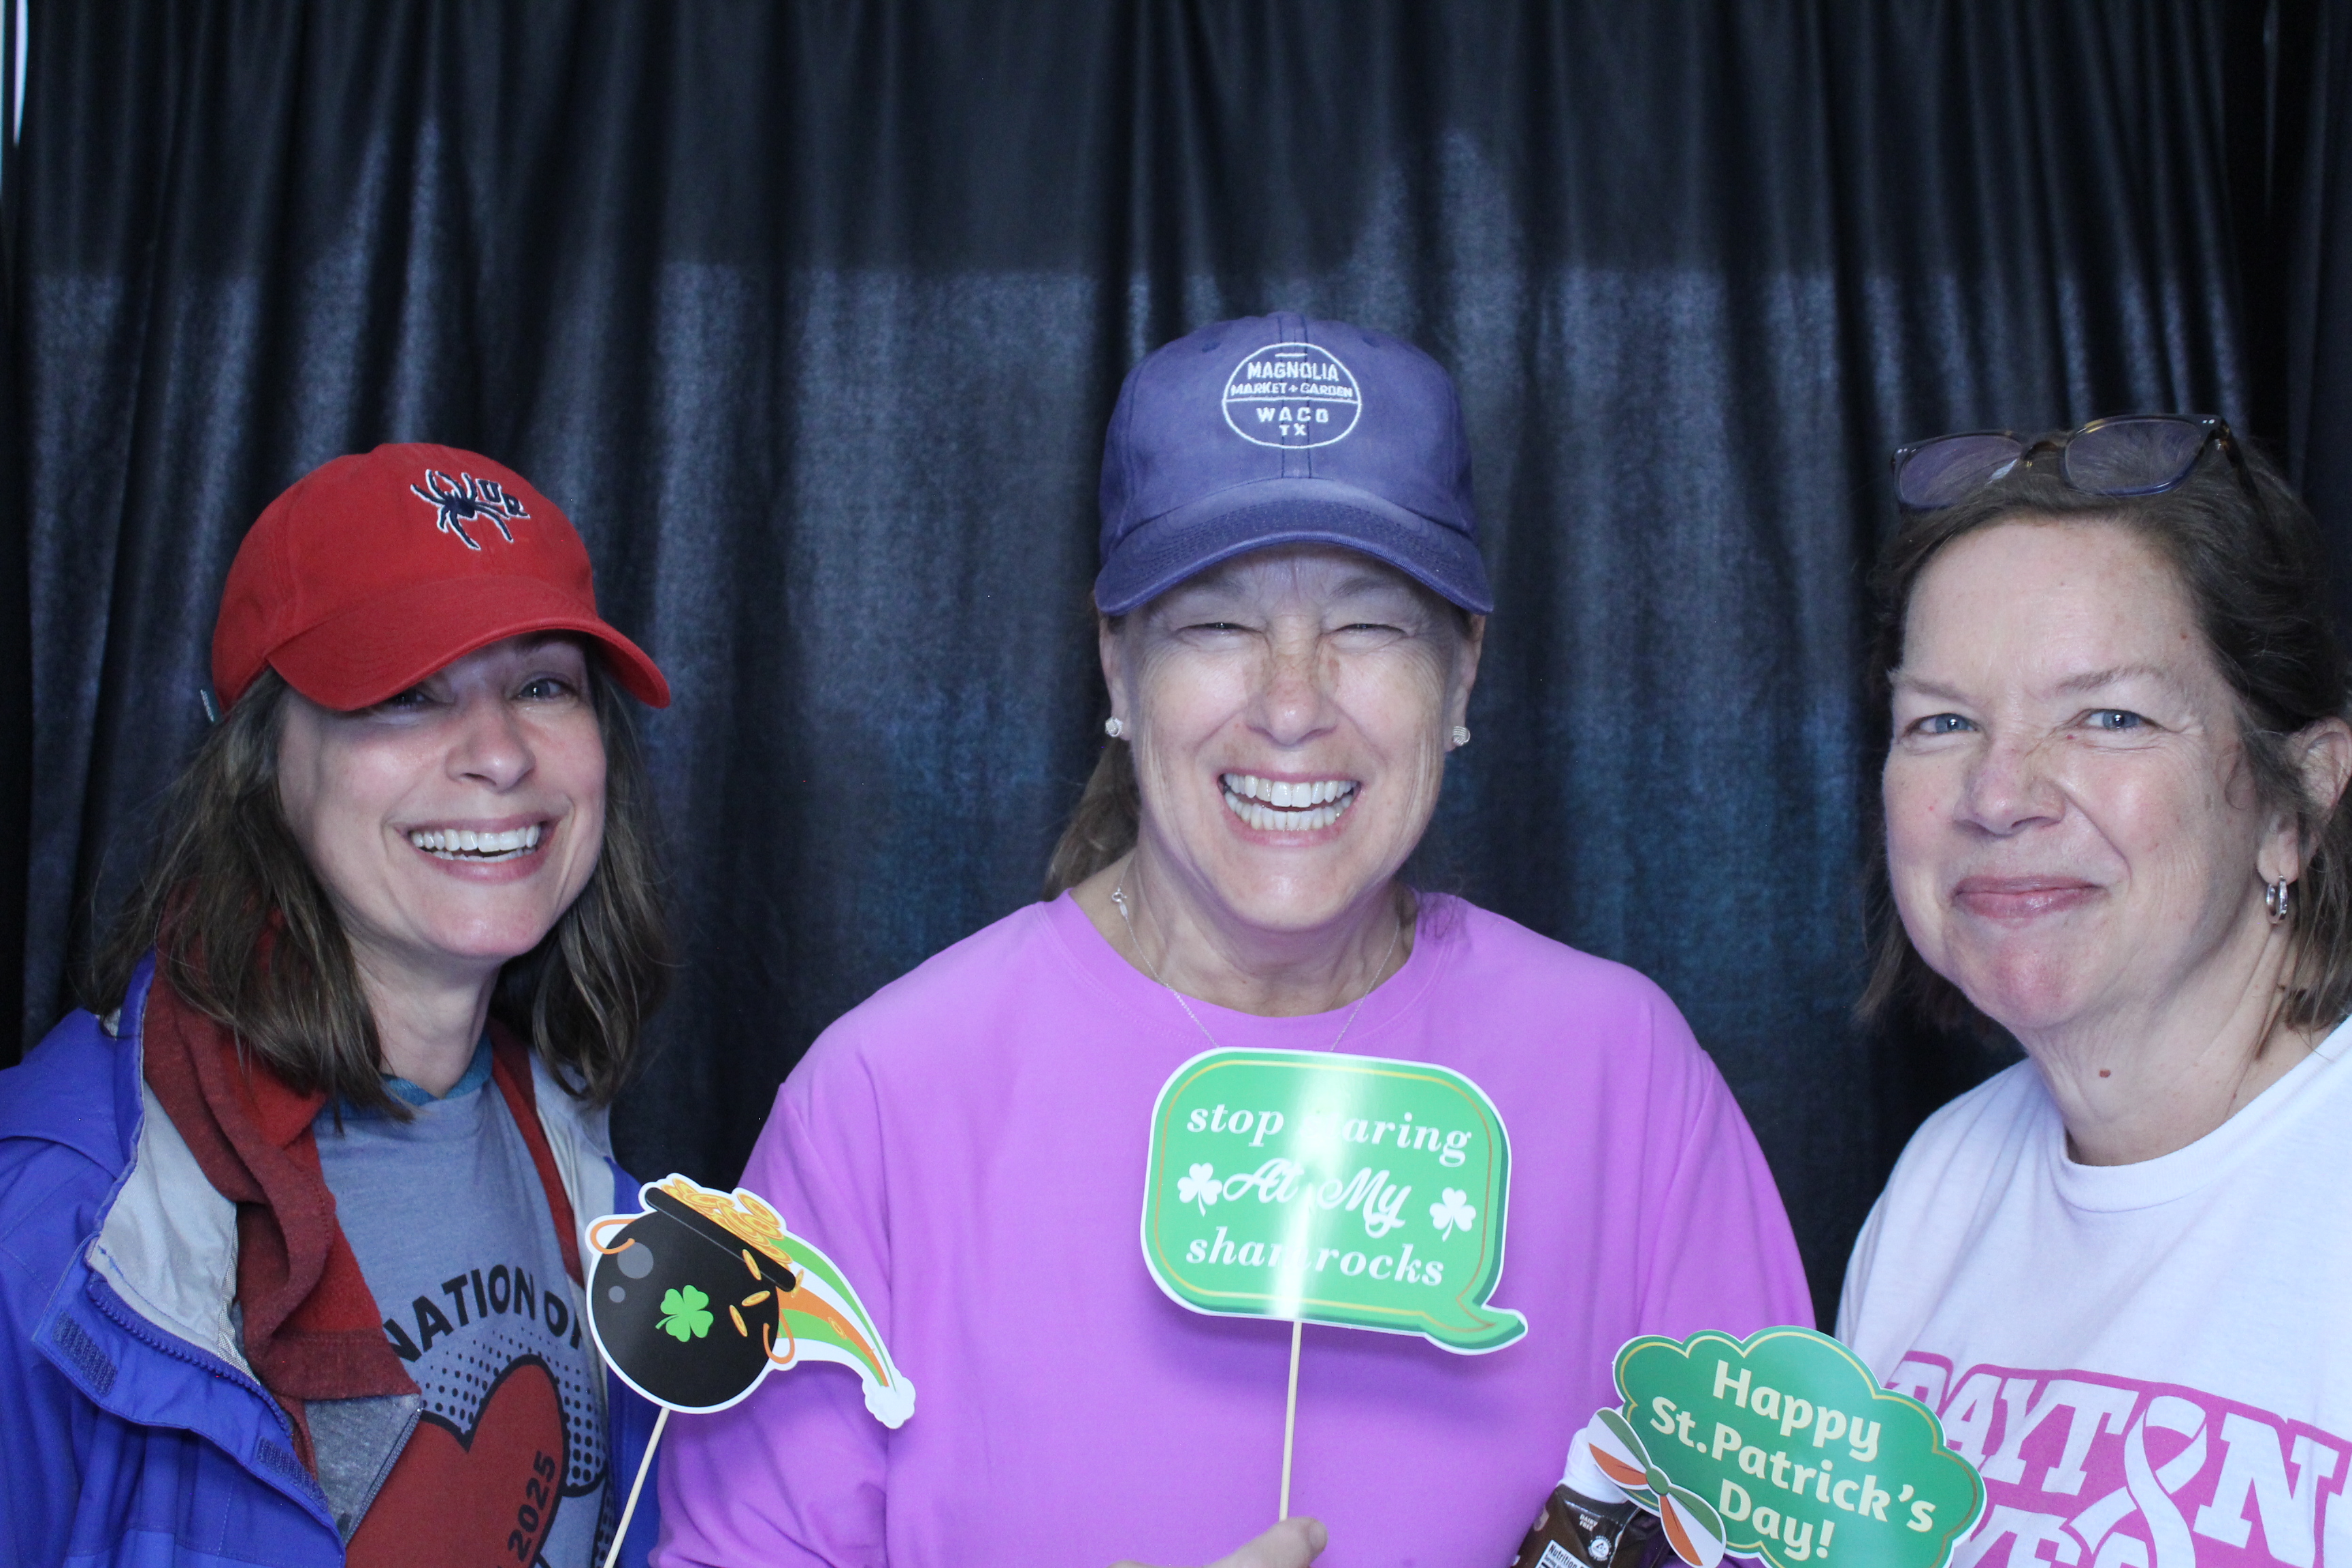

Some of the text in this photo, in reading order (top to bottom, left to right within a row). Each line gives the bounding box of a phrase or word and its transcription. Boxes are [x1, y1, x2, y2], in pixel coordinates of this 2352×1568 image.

[1247, 361, 1339, 381] MAGNOLIA
[1230, 381, 1288, 396] MARKET
[1300, 382, 1354, 397] GARDEN
[1256, 406, 1329, 423] WACO
[1279, 423, 1307, 436] TX
[1186, 1103, 1284, 1147] stop
[1222, 1157, 1412, 1239] At My
[1186, 1226, 1444, 1286] shamrocks
[1712, 1359, 1881, 1463] Happy
[507, 1450, 556, 1562] 2025
[1579, 1513, 1599, 1526] DAIRY
[1718, 1477, 1835, 1561] Day!
[1579, 1520, 1594, 1532] FREE
